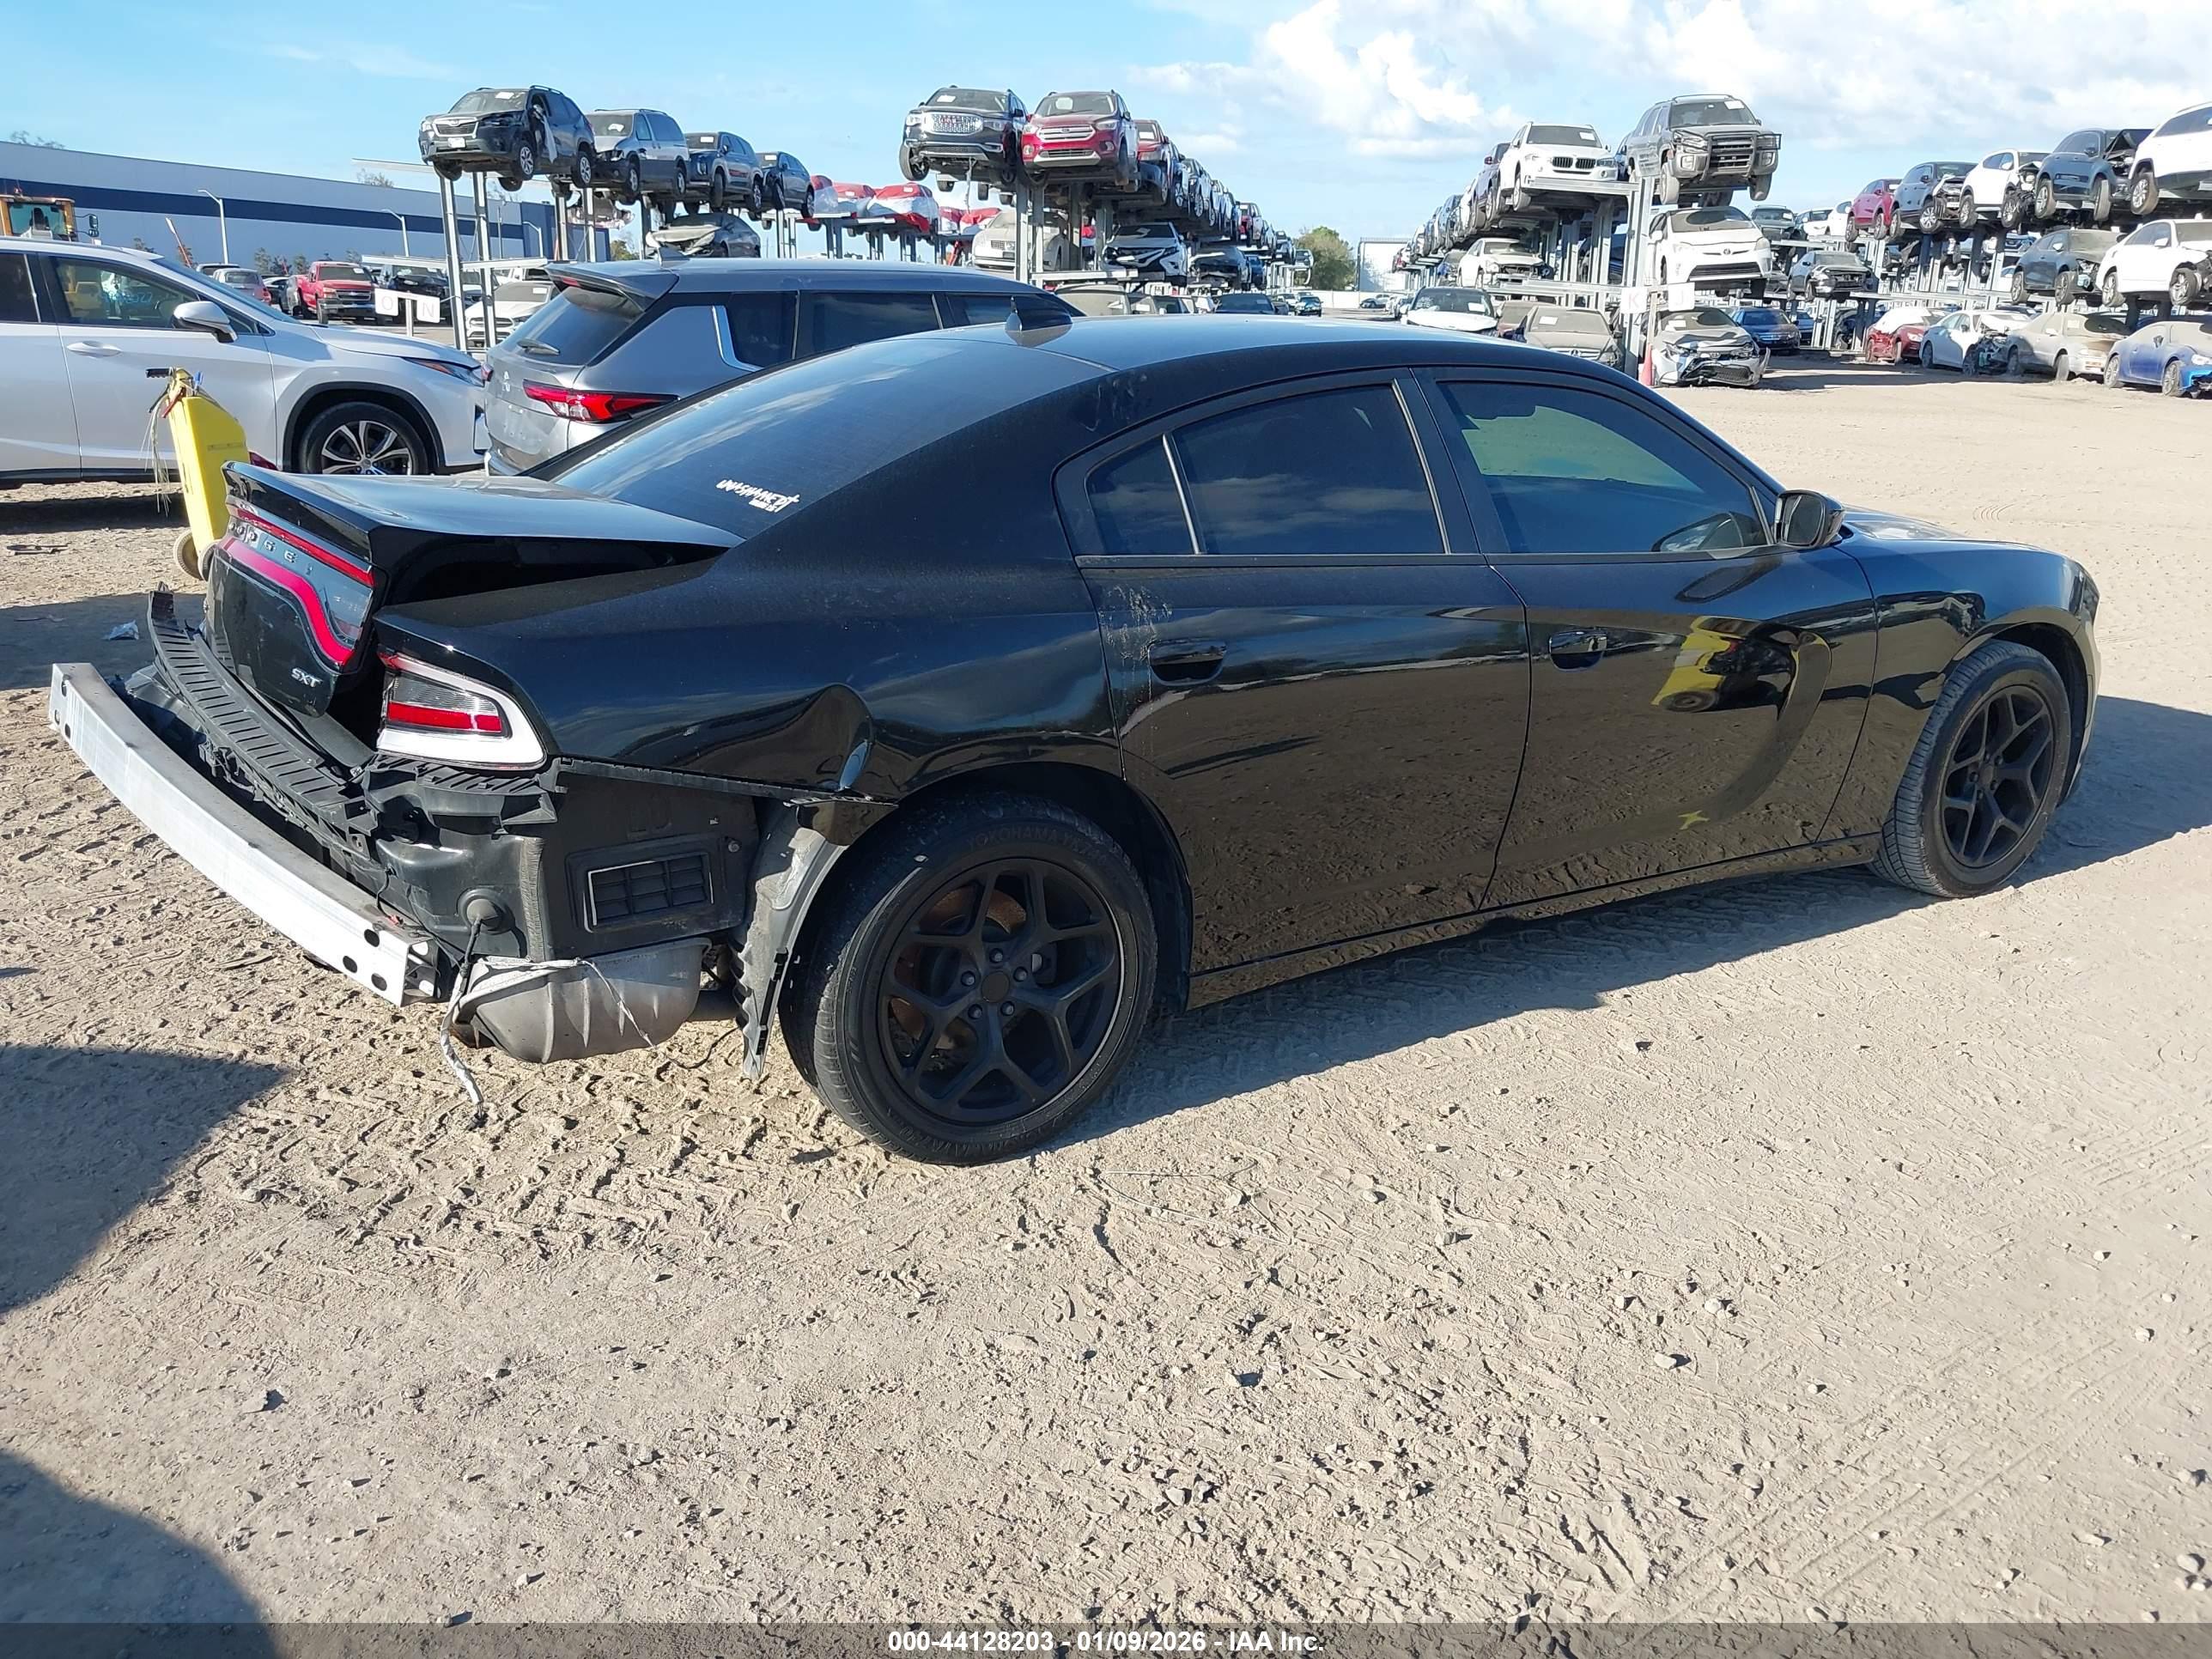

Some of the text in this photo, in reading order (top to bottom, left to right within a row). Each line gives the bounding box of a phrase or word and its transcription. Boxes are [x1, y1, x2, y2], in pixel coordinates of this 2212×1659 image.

[1628, 291, 1640, 309] K
[1674, 289, 1685, 307] J
[422, 301, 434, 318] N
[291, 667, 323, 688] SXT
[967, 824, 1059, 852] YOKOHAMA
